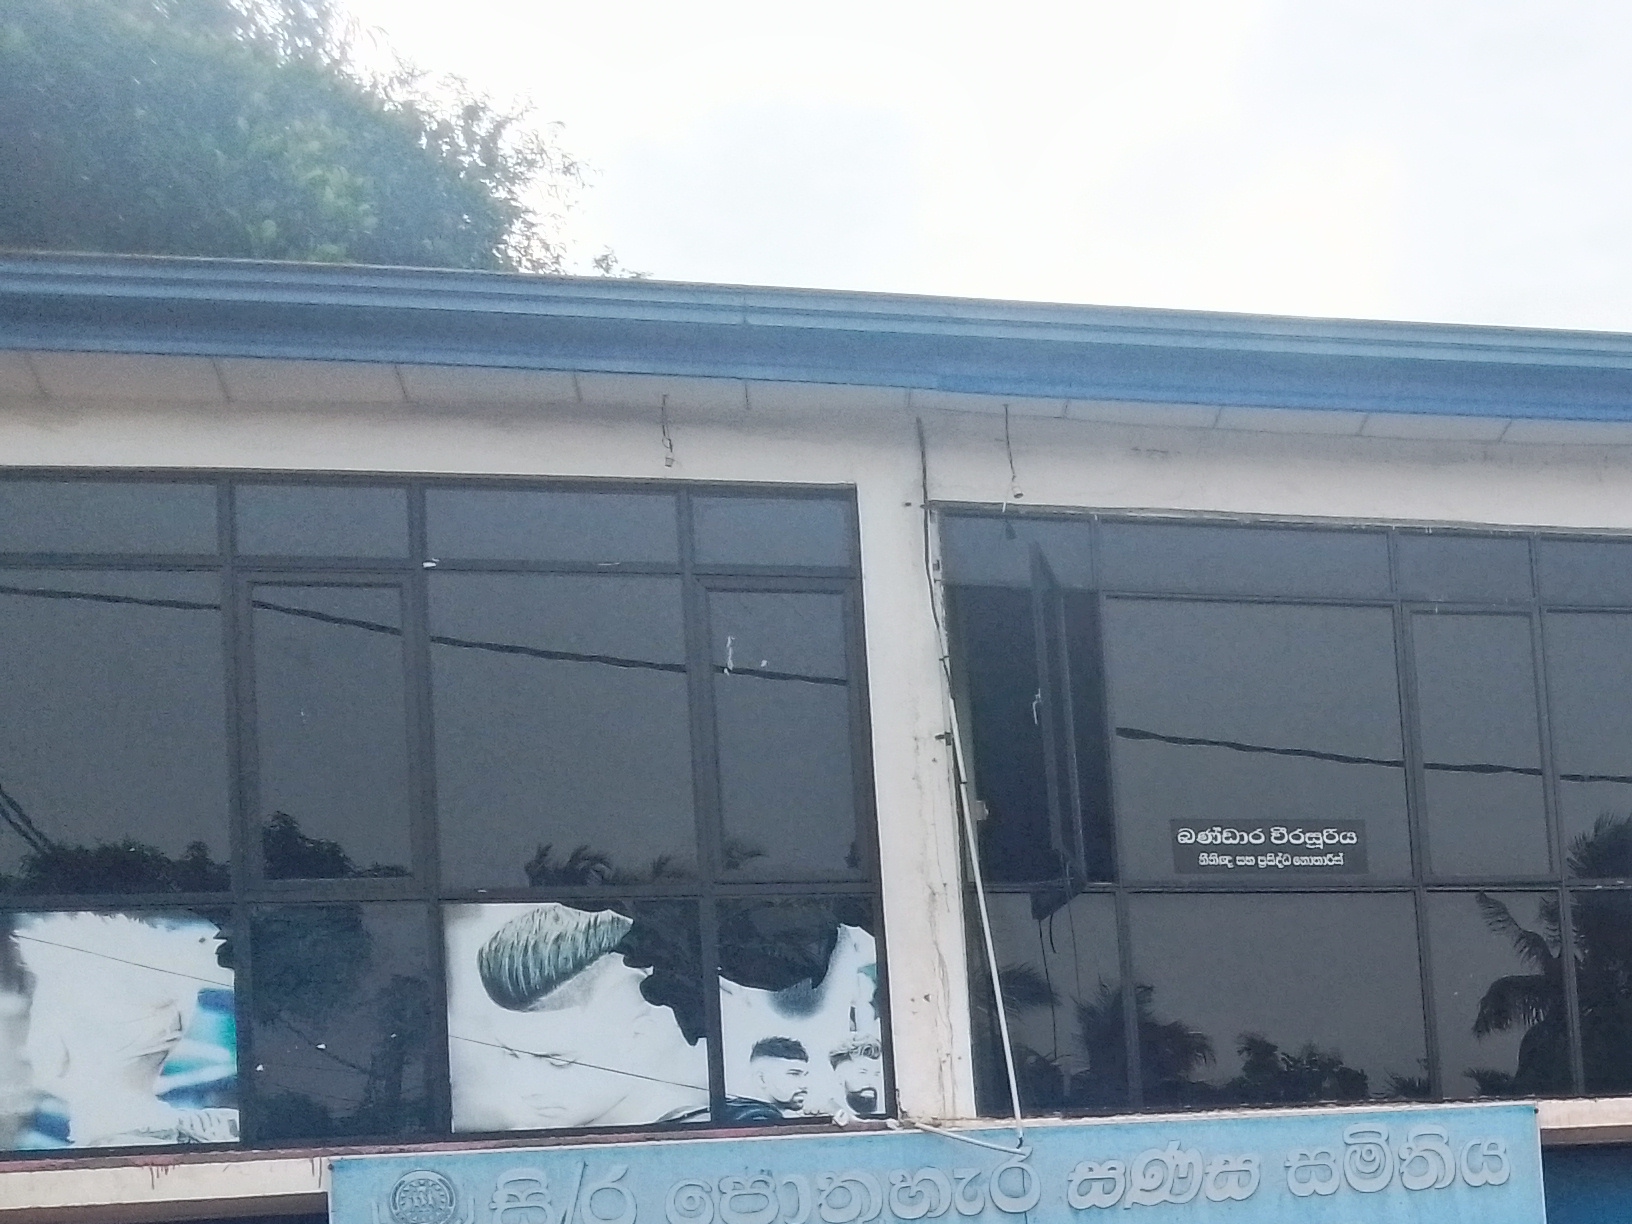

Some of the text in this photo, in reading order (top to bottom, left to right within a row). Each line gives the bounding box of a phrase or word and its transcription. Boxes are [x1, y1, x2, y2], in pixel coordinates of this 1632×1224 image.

[1177, 826, 1358, 849] බණ්ඩාර වීරසූරිය
[1236, 855, 1256, 866] සහ
[1284, 1122, 1511, 1198] සමිතිය
